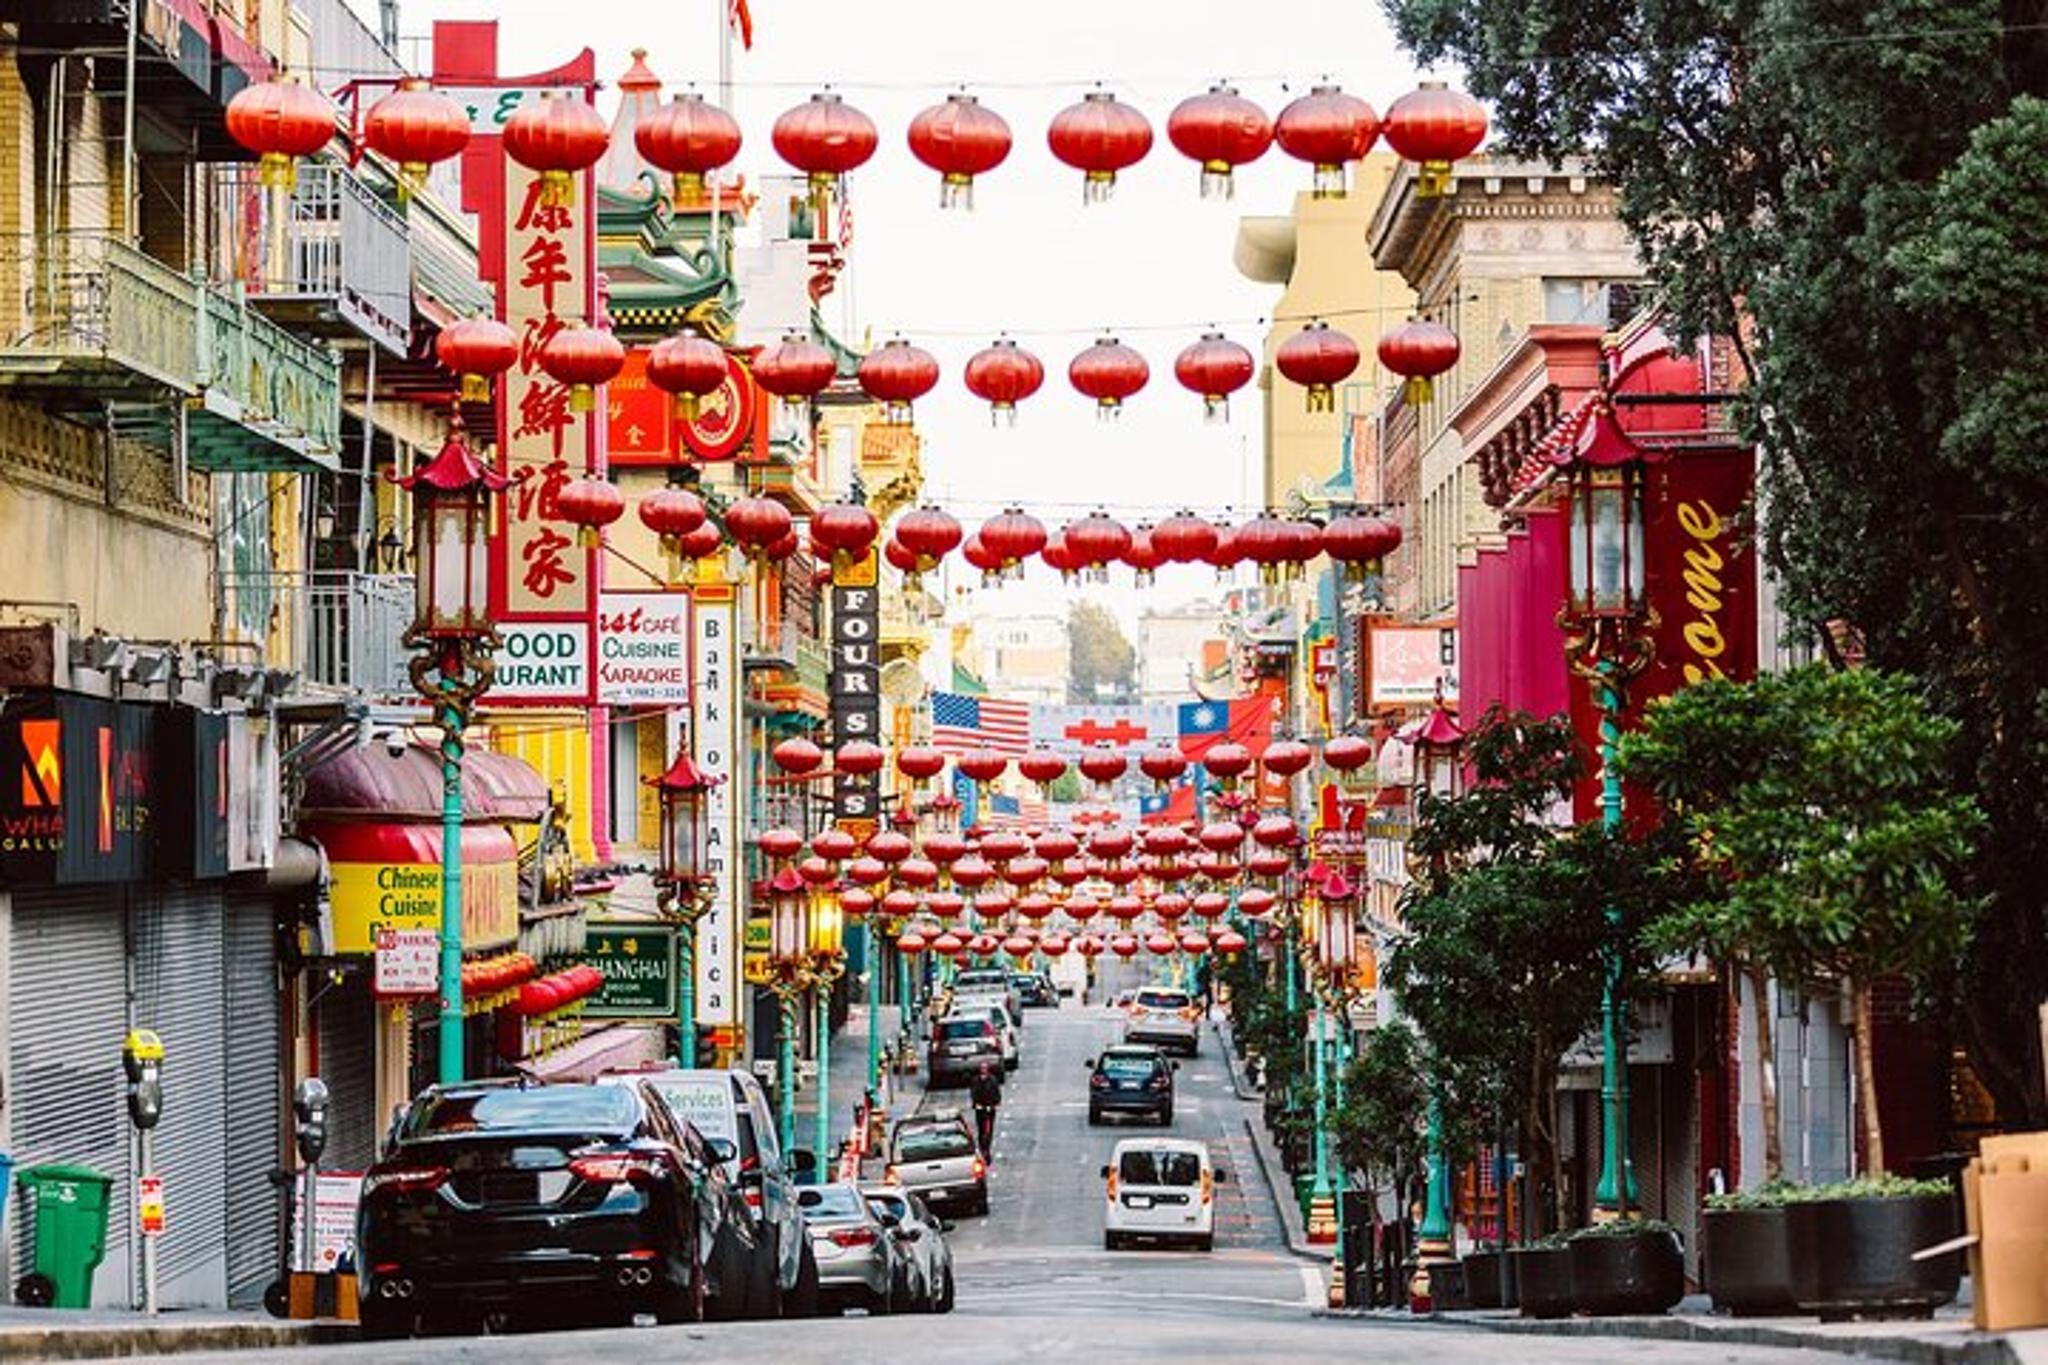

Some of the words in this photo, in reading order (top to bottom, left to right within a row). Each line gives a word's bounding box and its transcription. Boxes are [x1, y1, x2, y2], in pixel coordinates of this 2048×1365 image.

[705, 619, 720, 721] Bank
[843, 590, 870, 692] FOUR
[377, 867, 439, 890] Chinese
[379, 893, 438, 916] Cuisine
